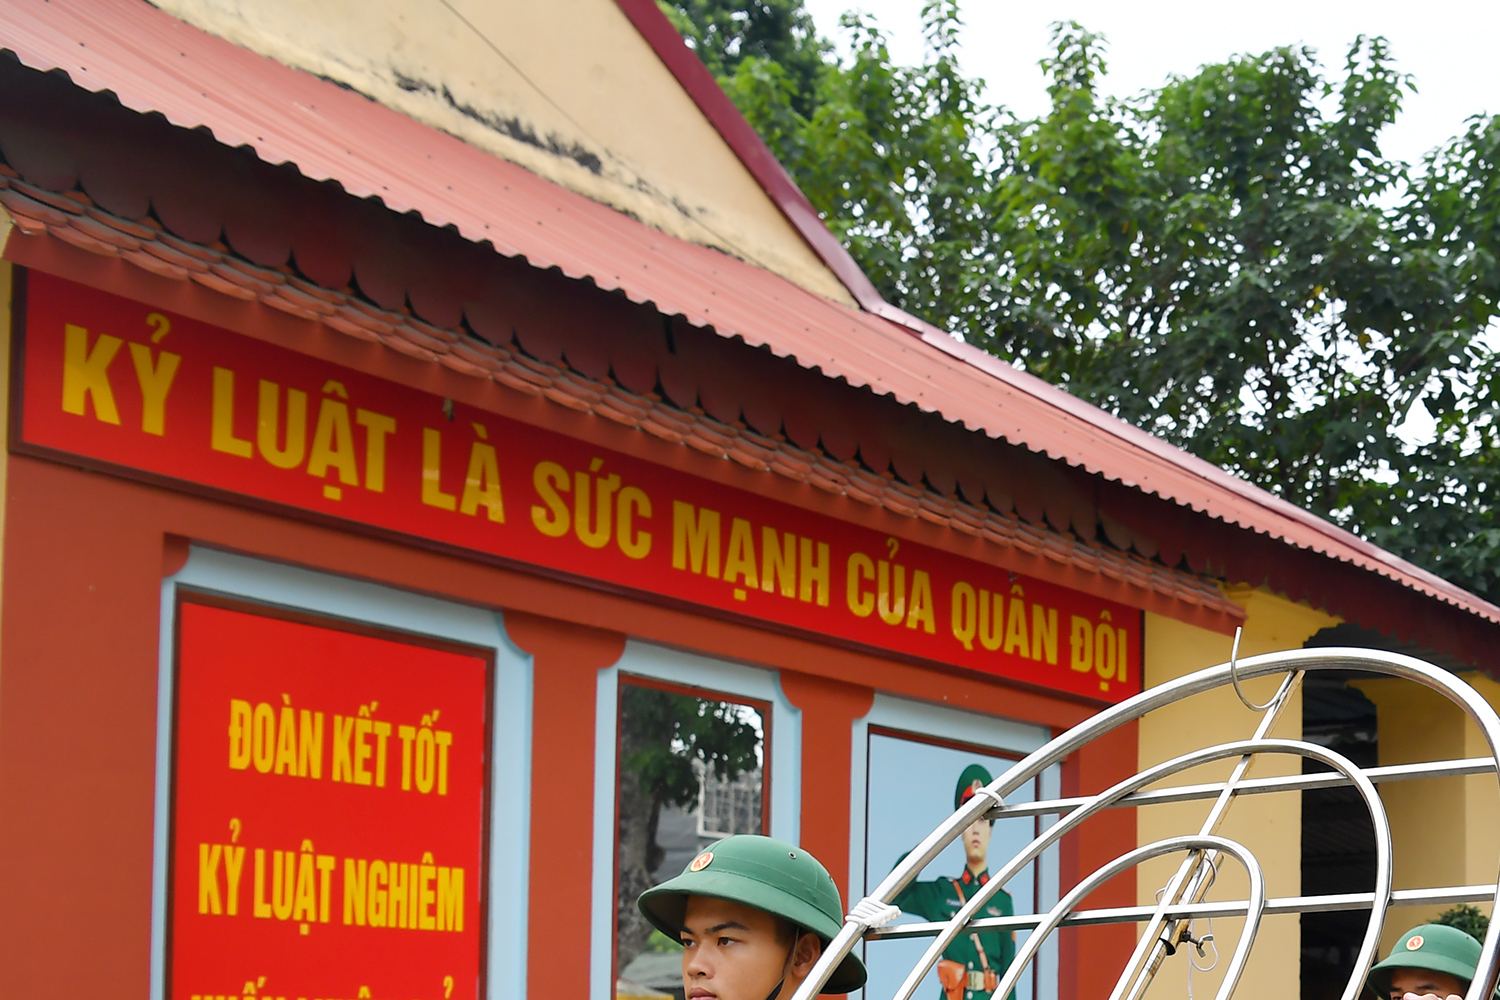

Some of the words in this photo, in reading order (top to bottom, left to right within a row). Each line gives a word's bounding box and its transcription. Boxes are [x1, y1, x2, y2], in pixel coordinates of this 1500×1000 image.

[62, 313, 180, 436] KỶ
[212, 367, 395, 500] LUẬT
[422, 423, 504, 523] LÀ
[531, 458, 651, 559] SỨC
[673, 501, 829, 605] MẠNH
[847, 538, 935, 633] CỦA
[952, 582, 1057, 664] QUÂN
[1070, 610, 1126, 691] ĐỘI
[229, 694, 324, 779] ĐOÀN
[332, 701, 391, 787] KẾT
[399, 710, 452, 795] TỐT
[199, 818, 245, 916] KỶ
[254, 839, 335, 935] LUẬT
[343, 852, 464, 932] NGHIÊM
